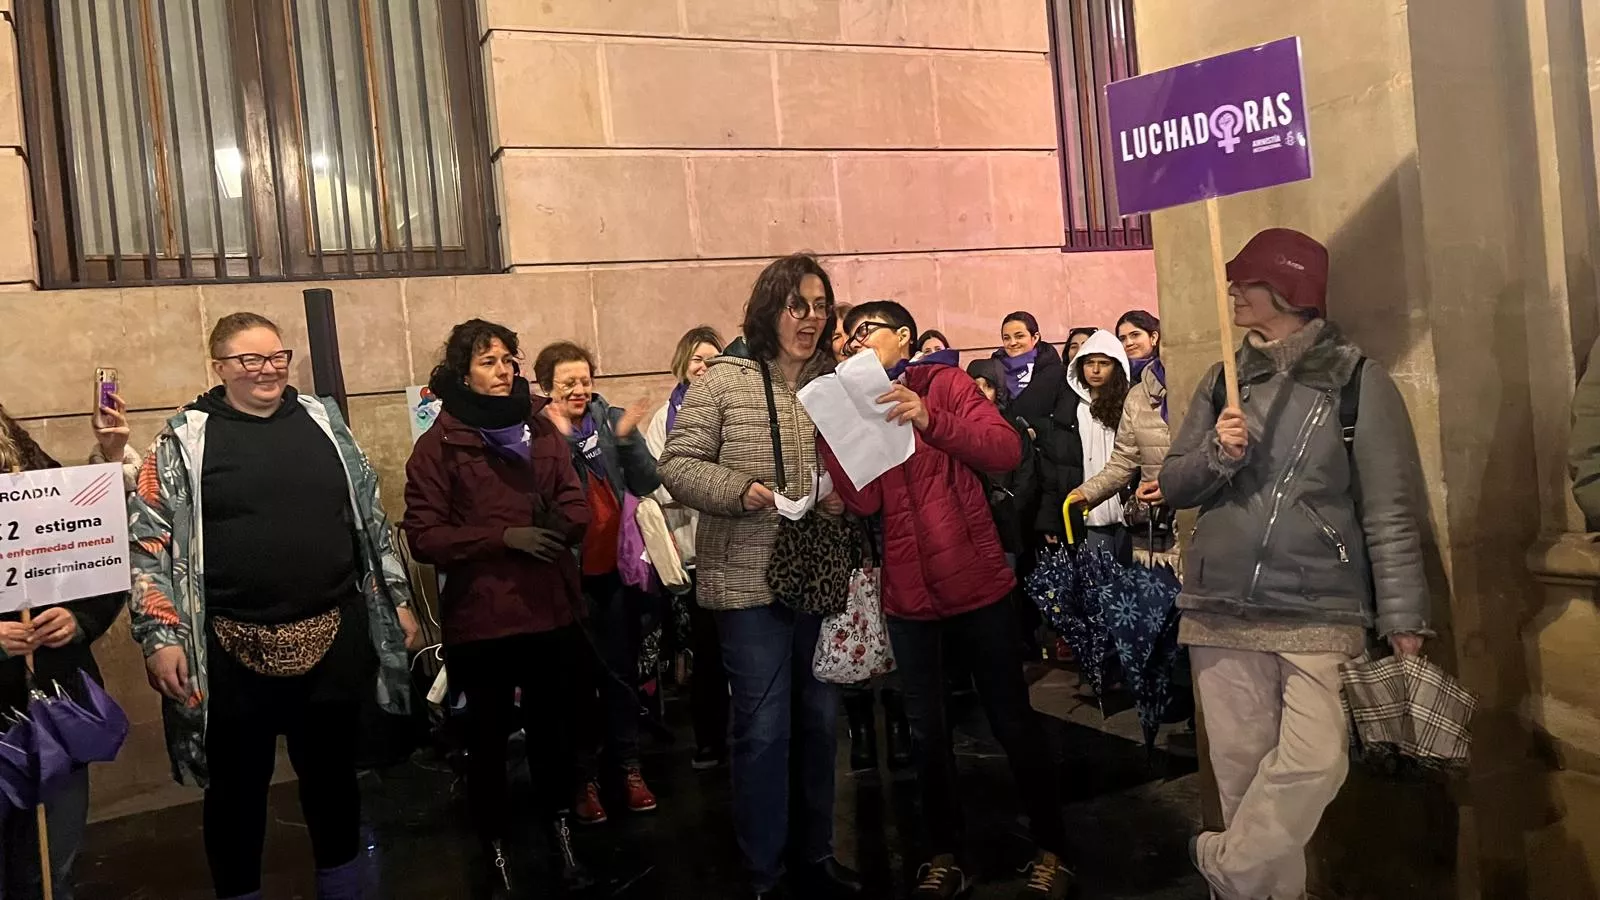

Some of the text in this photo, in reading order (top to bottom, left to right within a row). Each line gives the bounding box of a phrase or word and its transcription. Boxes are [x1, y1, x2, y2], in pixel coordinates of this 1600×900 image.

[1120, 92, 1293, 162] LUCHADORAS
[35, 516, 102, 534] estigma
[7, 541, 75, 559] enfermedad
[77, 535, 115, 549] mental
[24, 555, 122, 579] discriminación
